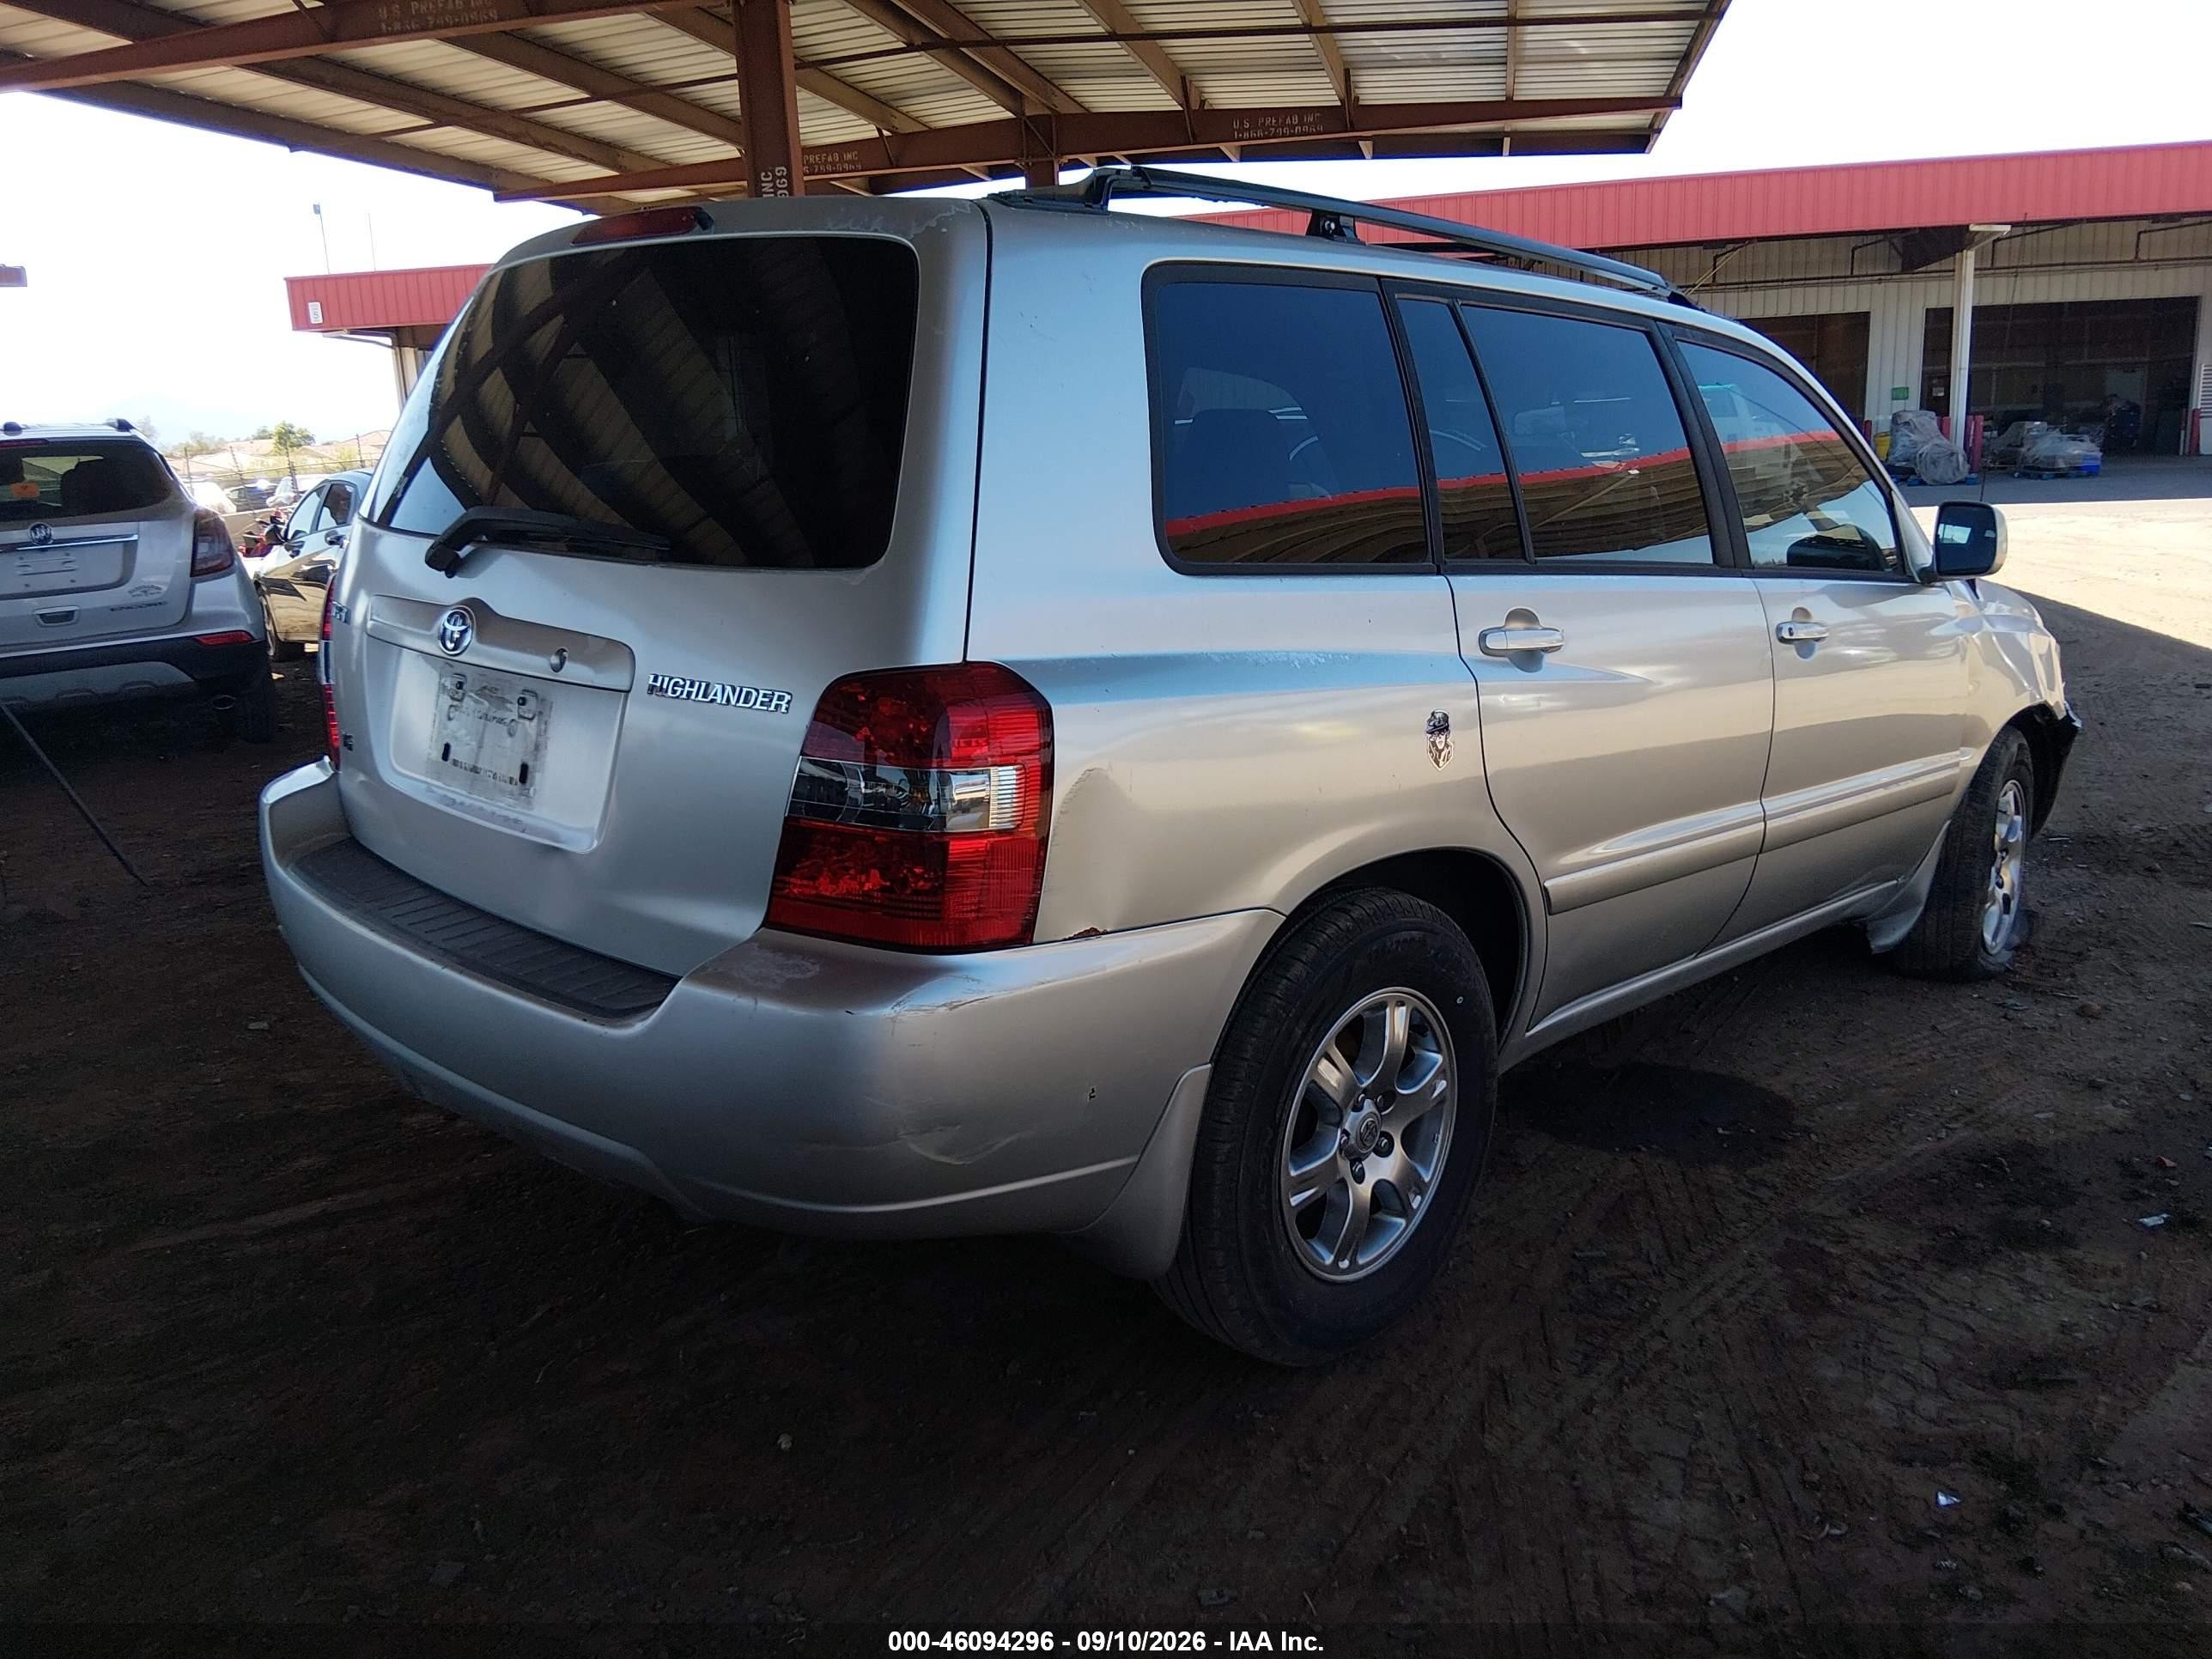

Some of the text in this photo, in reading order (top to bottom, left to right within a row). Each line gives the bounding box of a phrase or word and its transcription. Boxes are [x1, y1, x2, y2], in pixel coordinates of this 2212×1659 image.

[1258, 113, 1298, 127] PREFAB
[761, 171, 775, 198] INC
[647, 673, 793, 714] HIGHLANDER
